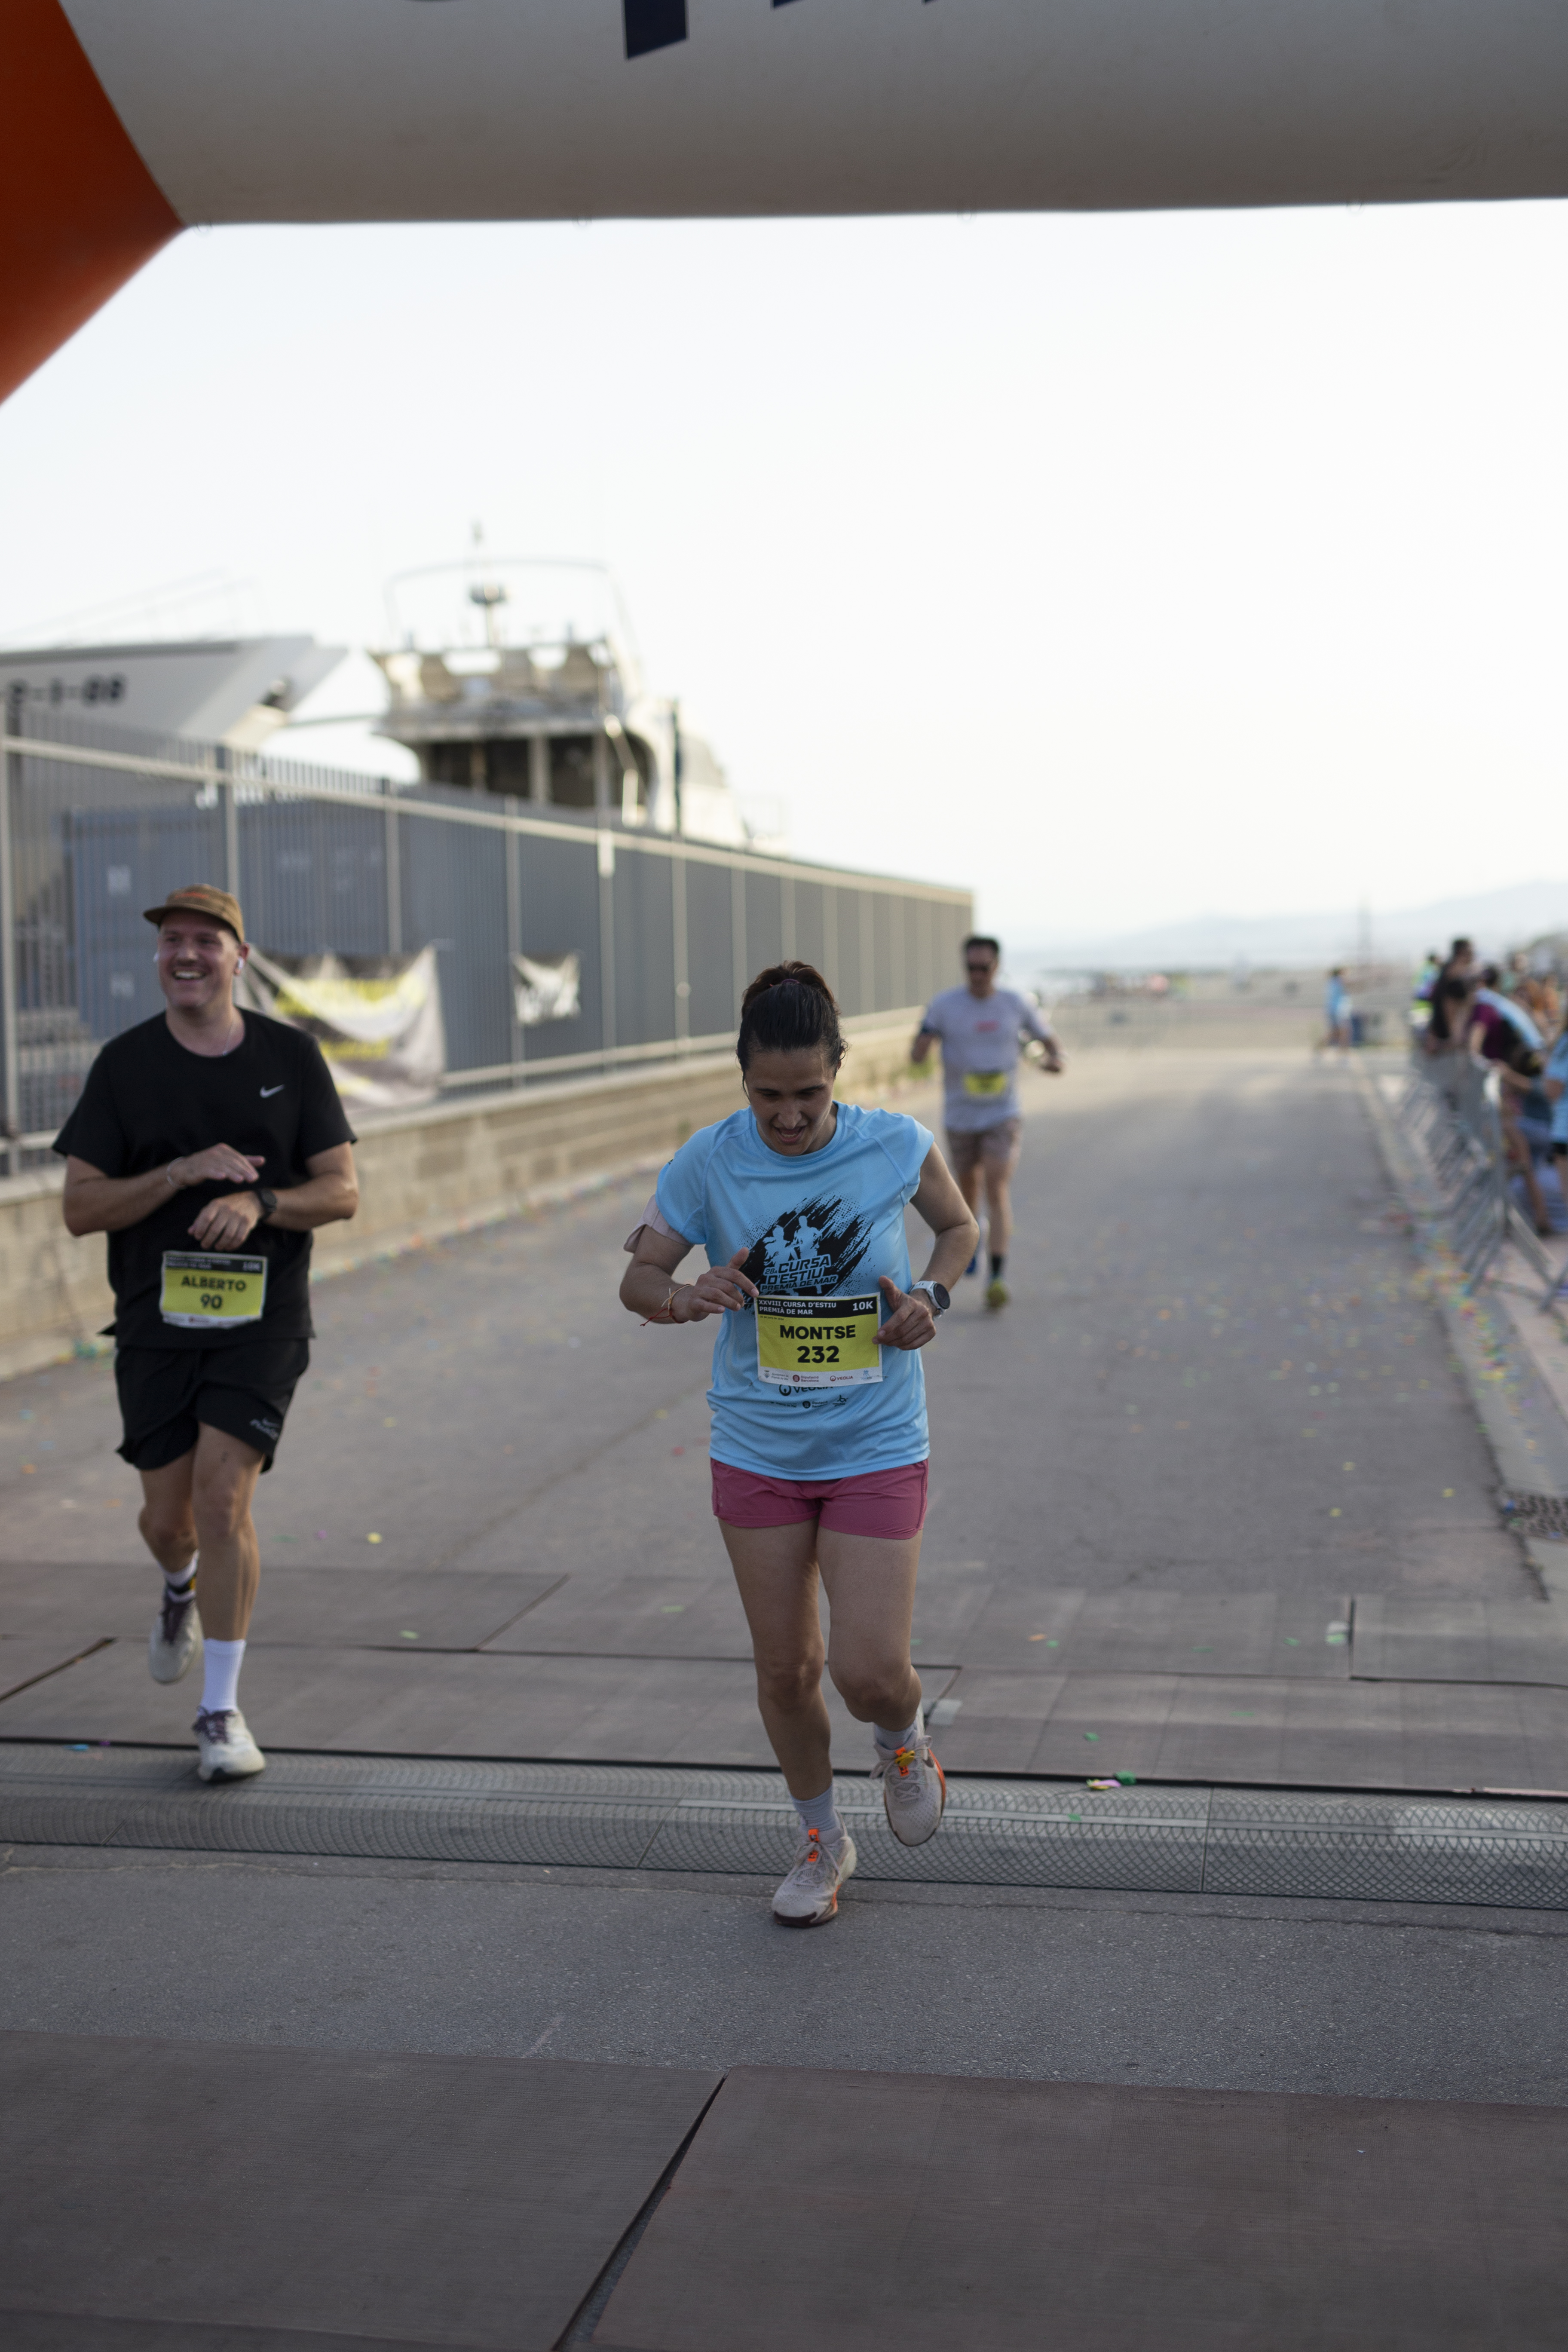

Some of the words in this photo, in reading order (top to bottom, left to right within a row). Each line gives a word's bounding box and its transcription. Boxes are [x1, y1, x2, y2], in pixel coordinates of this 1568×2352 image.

[778, 1256, 830, 1274] CURSA
[181, 1274, 247, 1292] ALBERTO
[768, 1268, 823, 1284] D'ESTIU
[799, 1279, 813, 1287] DE
[814, 1276, 837, 1285] MAR
[200, 1293, 223, 1310] 90
[852, 1301, 873, 1311] 10K
[780, 1324, 856, 1340] MONTSE
[796, 1345, 839, 1363] 232
